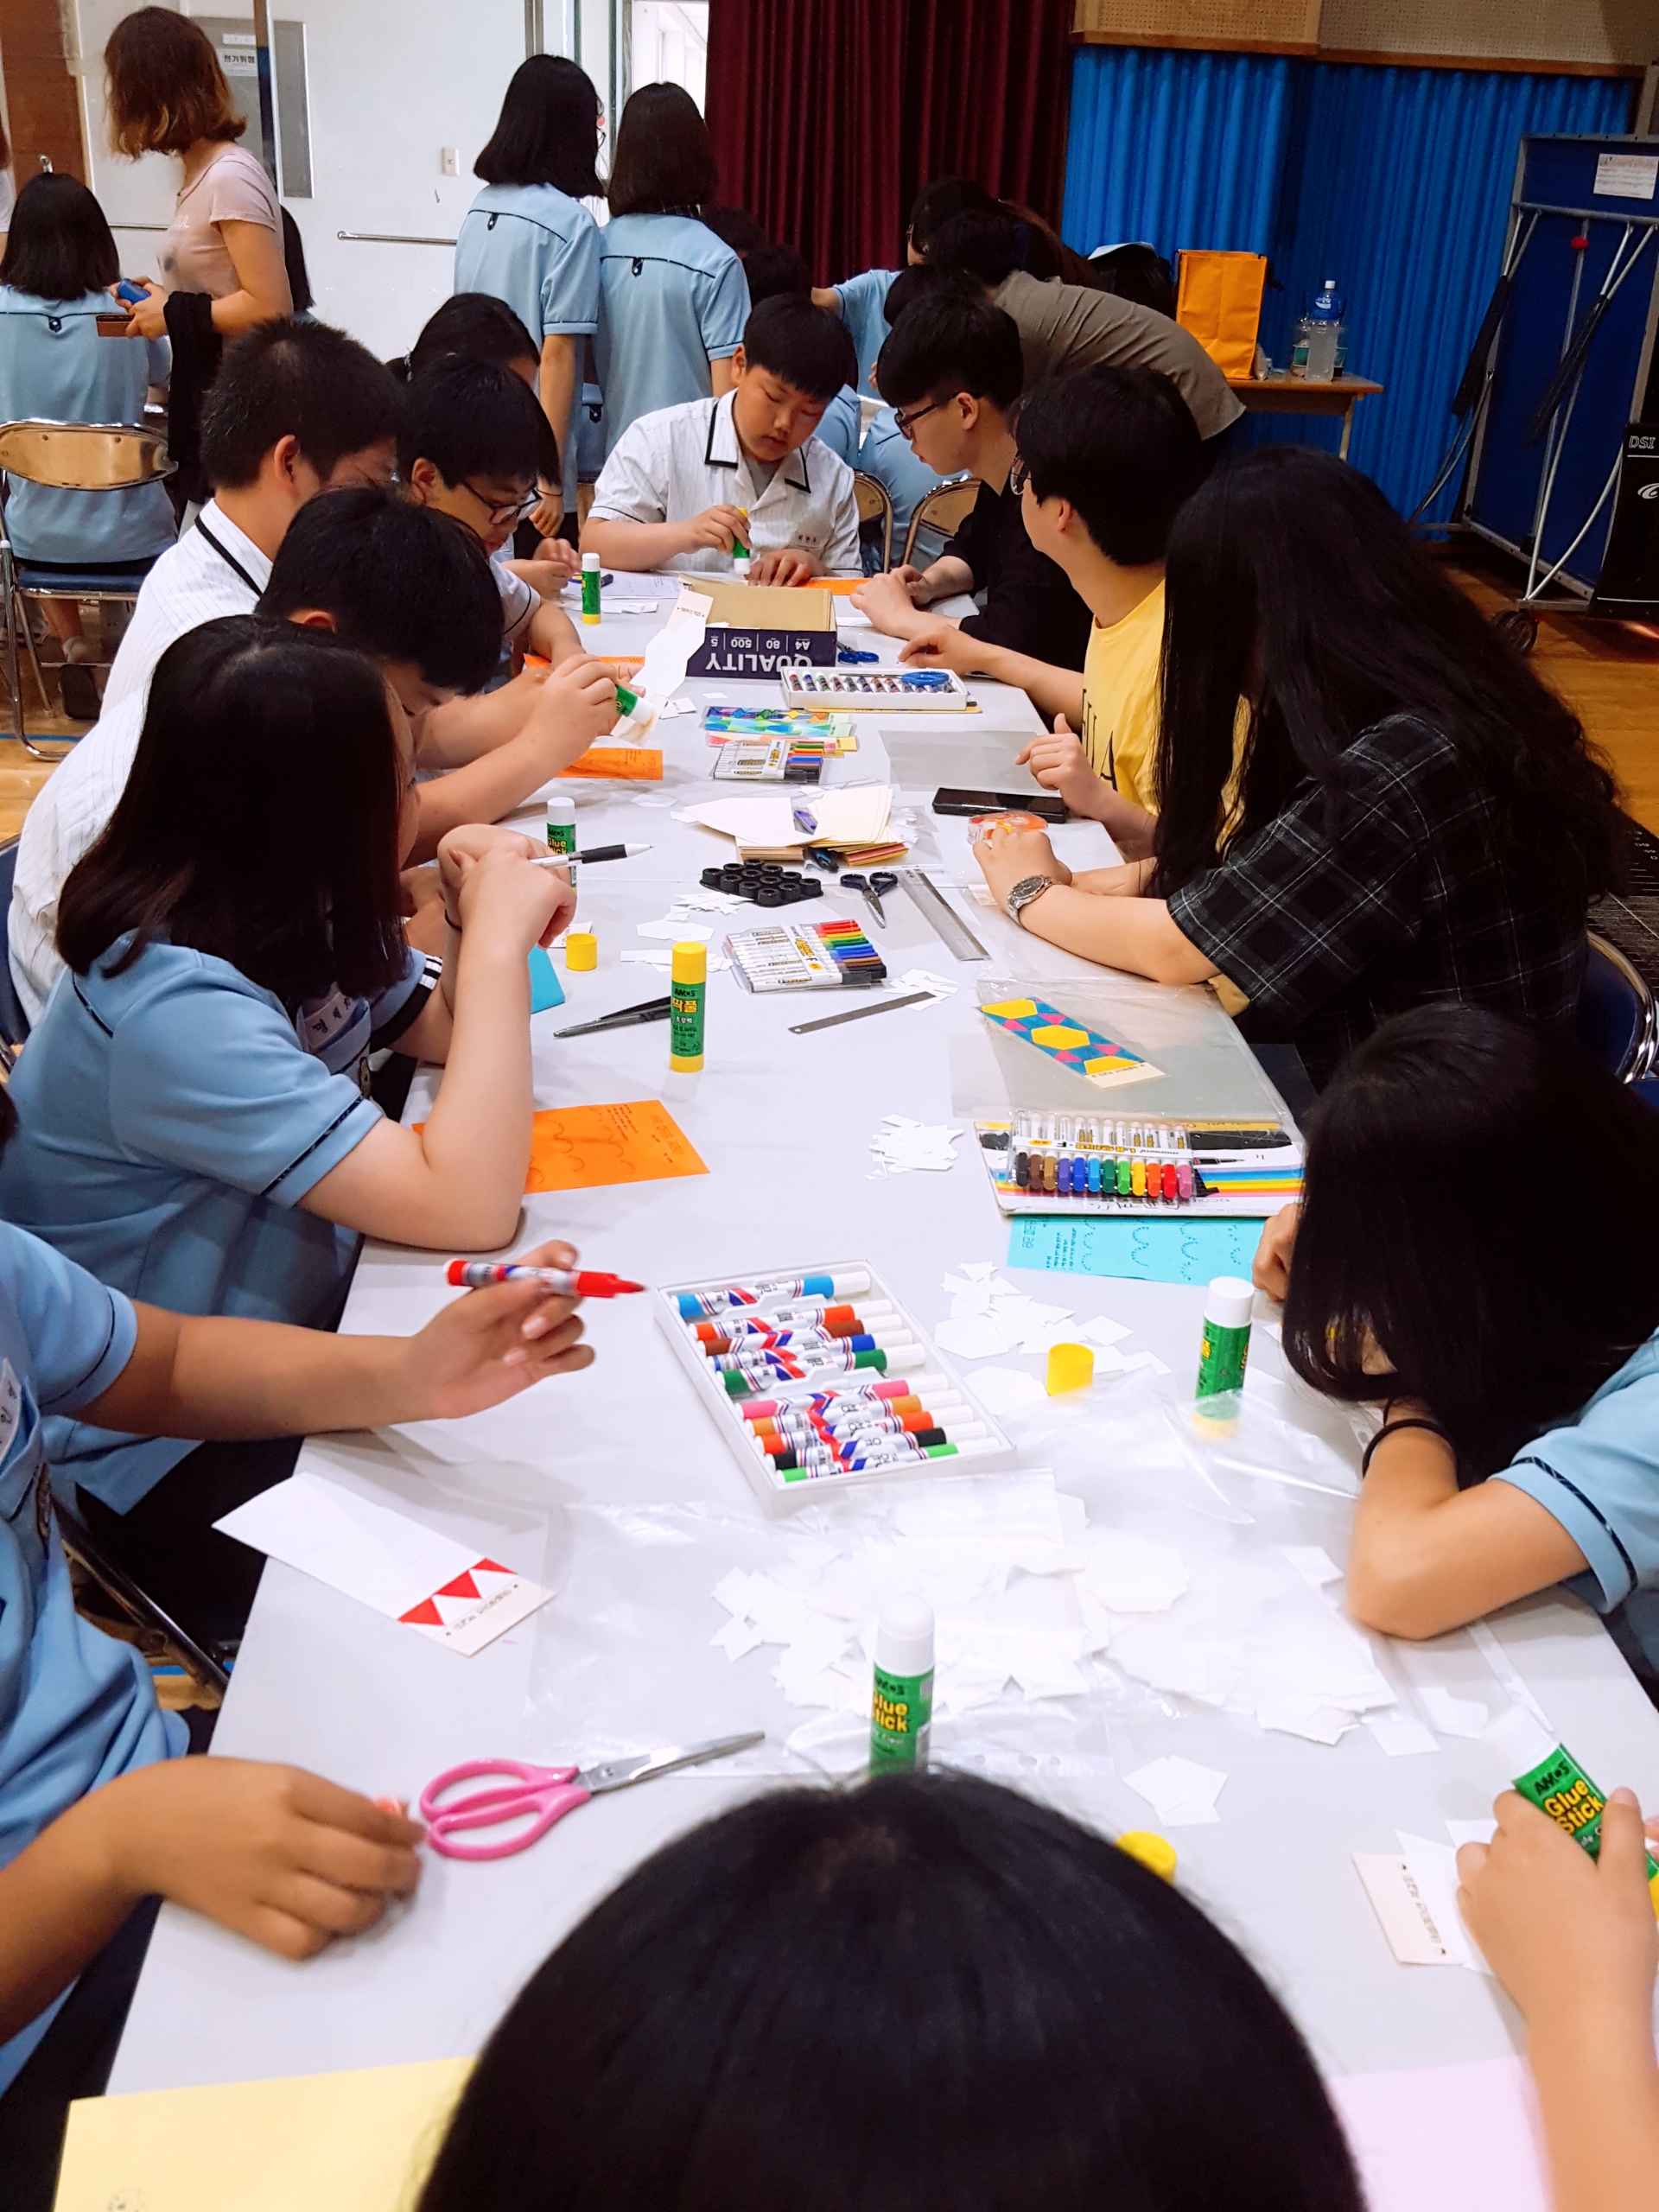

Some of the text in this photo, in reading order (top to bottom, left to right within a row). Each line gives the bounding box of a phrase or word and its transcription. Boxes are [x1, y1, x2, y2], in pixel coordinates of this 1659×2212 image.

[1629, 435, 1656, 449] DSI
[710, 638, 719, 647] 5
[730, 639, 753, 649] 500
[766, 639, 780, 650] 80
[795, 640, 810, 651] A4
[705, 652, 812, 672] QUALITY
[548, 836, 567, 848] Glue
[674, 988, 696, 997] AMOS
[1535, 1760, 1570, 1796] AMOS
[1544, 1779, 1589, 1817] Glue
[1556, 1796, 1605, 1835] Stick
